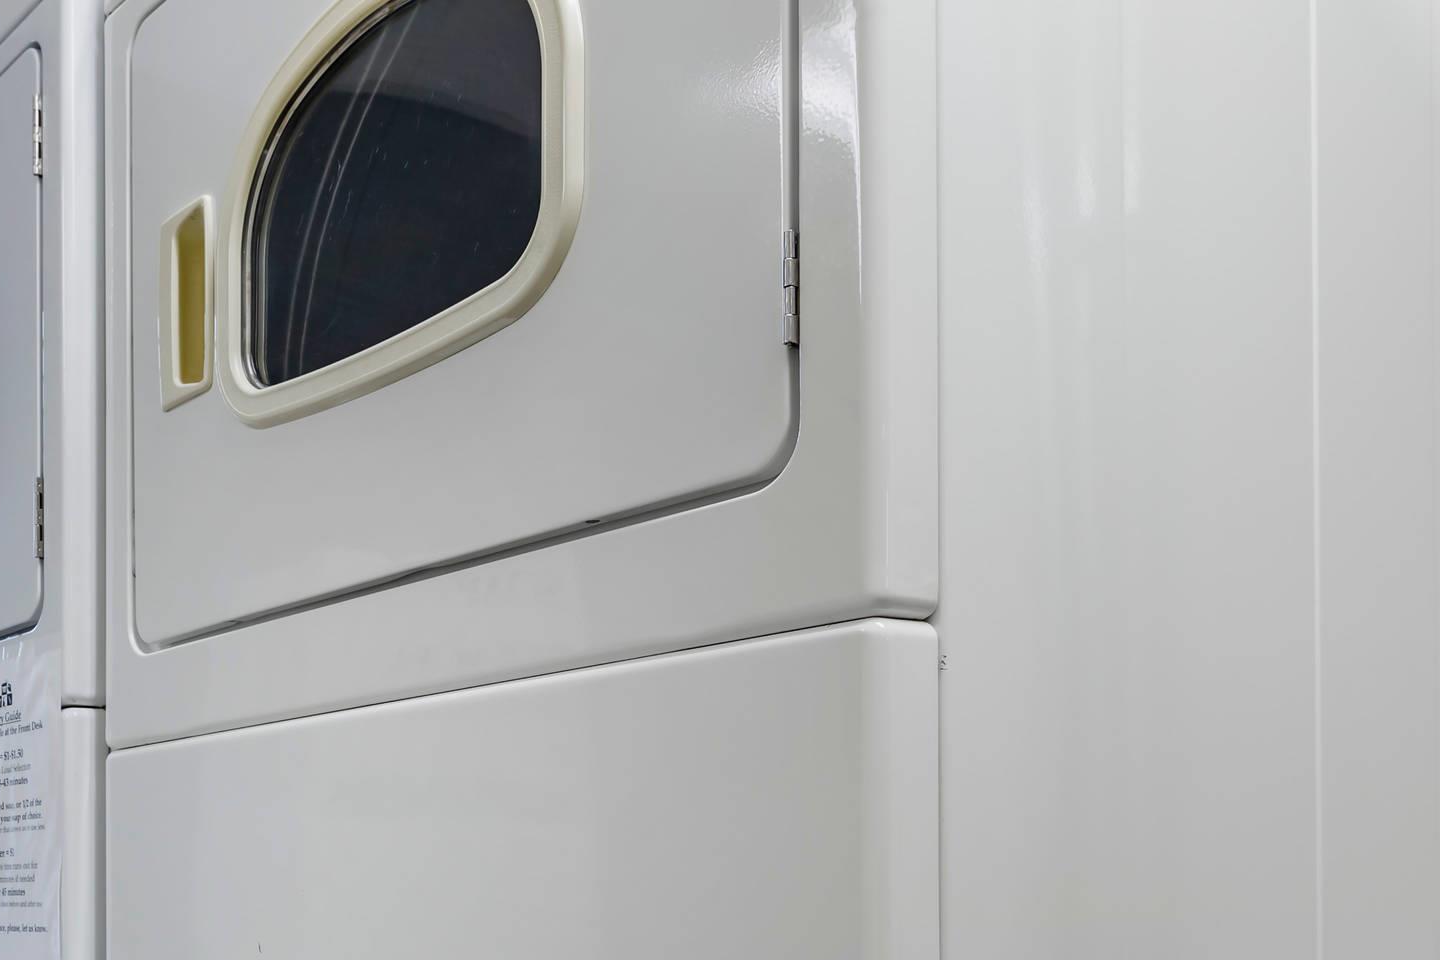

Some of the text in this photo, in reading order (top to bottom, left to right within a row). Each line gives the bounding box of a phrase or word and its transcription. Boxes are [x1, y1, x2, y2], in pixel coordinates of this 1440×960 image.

[5, 710, 21, 721] Guide
[5, 728, 9, 736] at
[18, 724, 31, 733] Front
[32, 720, 43, 730] Desk
